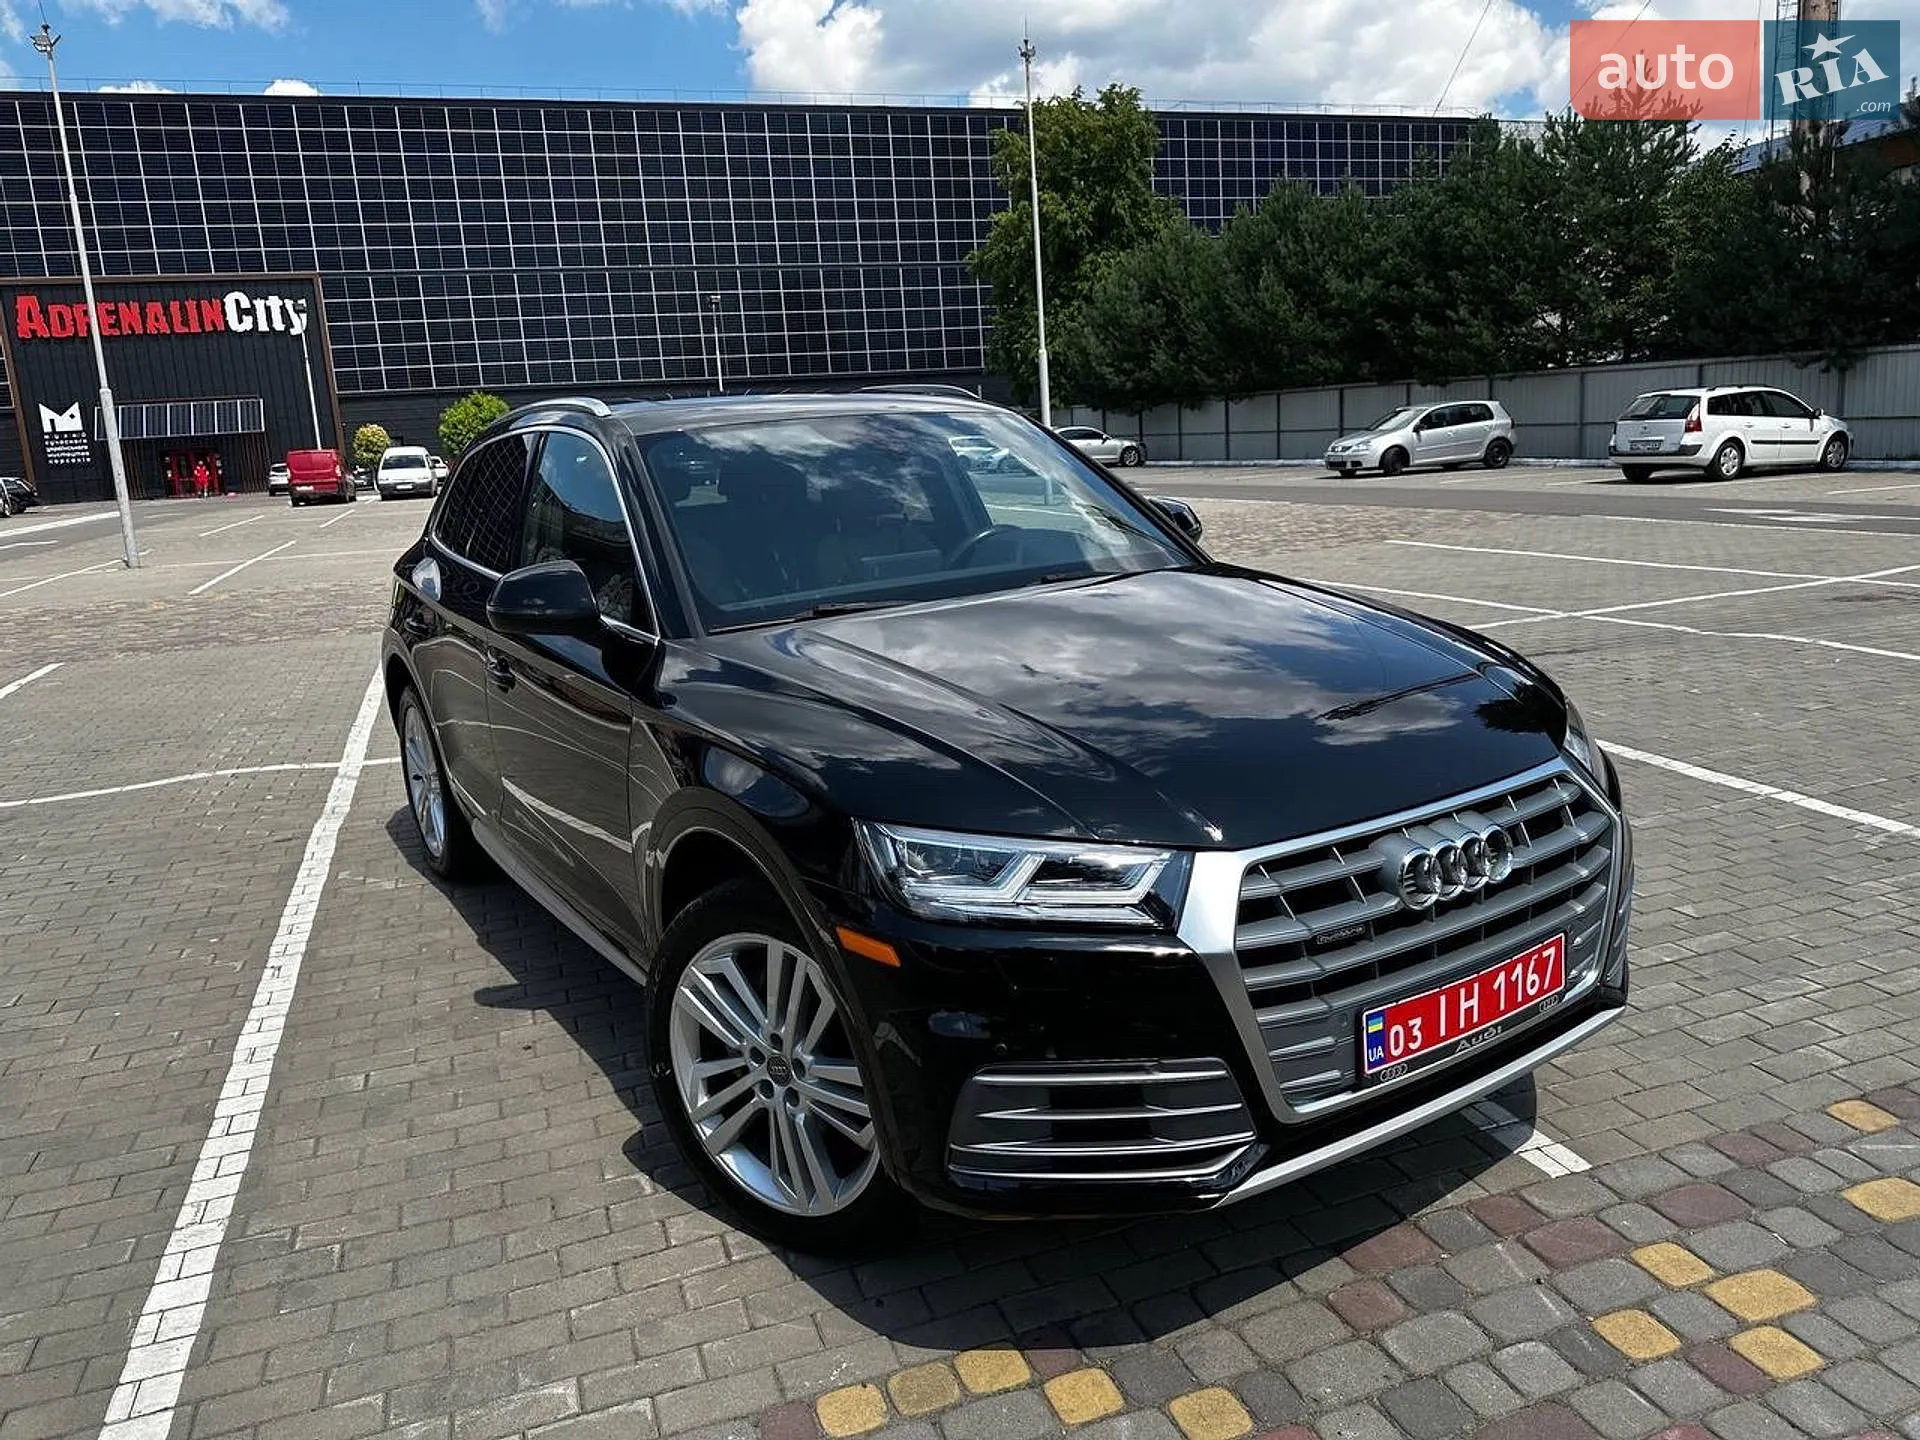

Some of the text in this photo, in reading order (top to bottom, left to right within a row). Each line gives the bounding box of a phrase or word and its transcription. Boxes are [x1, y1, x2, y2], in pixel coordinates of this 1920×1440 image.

[1390, 1016, 1422, 1057] 03
[1492, 946, 1556, 1012] 1167
[1368, 1048, 1385, 1062] UA
